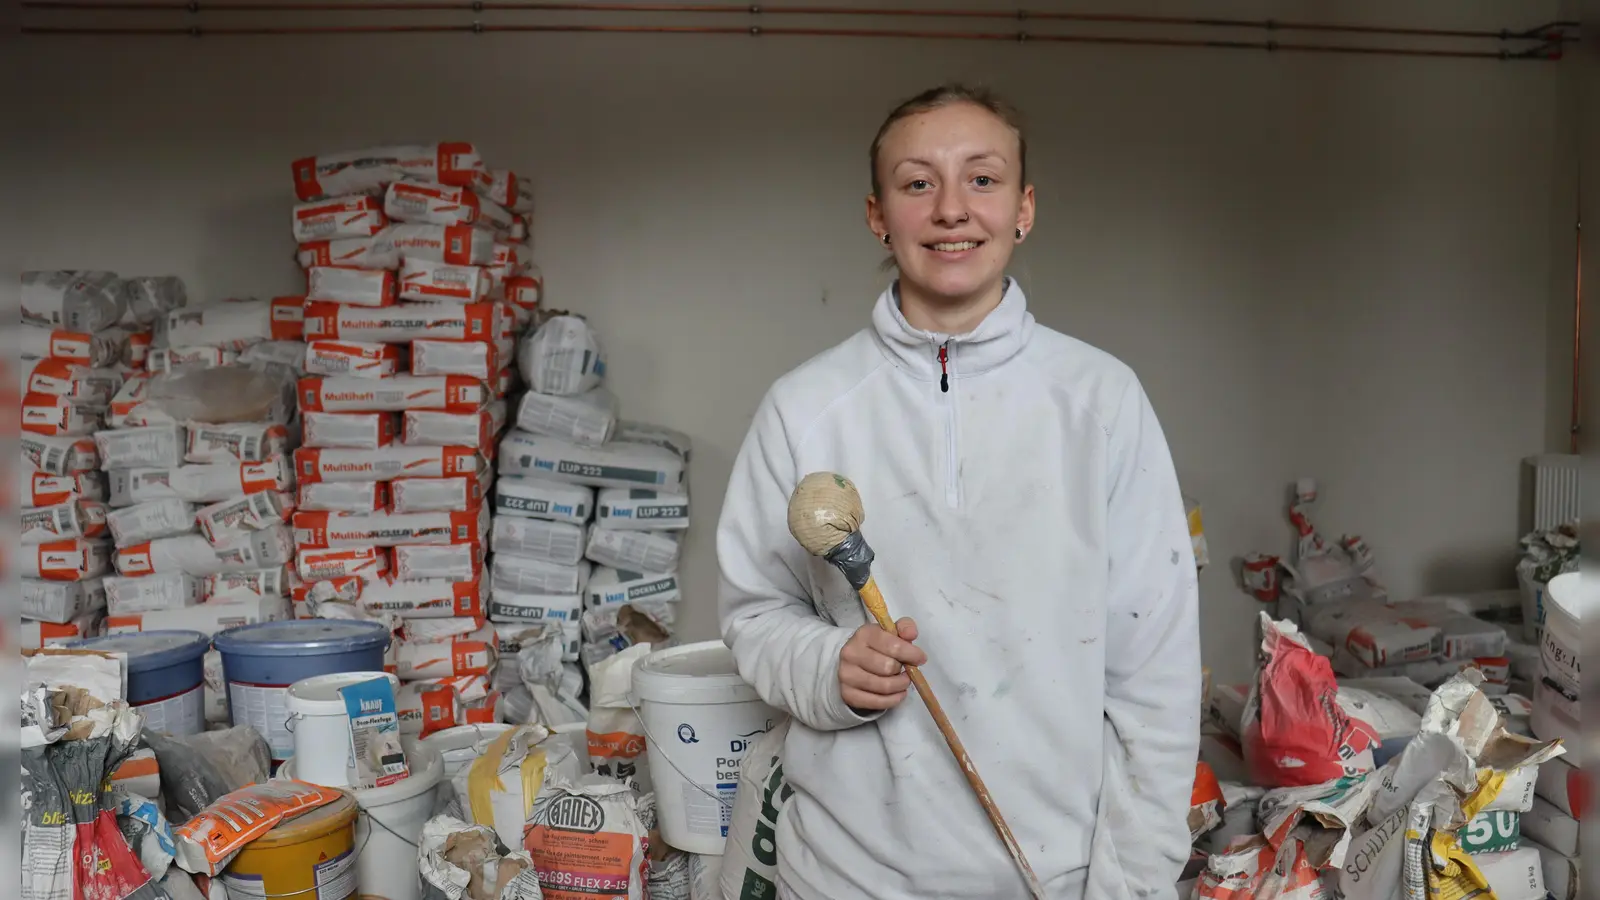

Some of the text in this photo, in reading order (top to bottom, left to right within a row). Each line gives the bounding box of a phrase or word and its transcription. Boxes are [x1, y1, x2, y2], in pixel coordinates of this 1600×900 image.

[325, 392, 374, 402] Multihaft
[323, 463, 372, 472] Multihaft
[560, 463, 581, 473] LUP
[582, 465, 602, 476] 222
[505, 498, 547, 512] LUP 222
[638, 507, 659, 517] LUP
[661, 507, 681, 517] 222
[500, 606, 542, 618] LUP 222
[360, 698, 383, 712] KNAUF
[550, 798, 599, 828] ARDEX
[1466, 811, 1516, 845] 50
[550, 871, 572, 885] G9S
[574, 877, 601, 889] FLEX
[603, 880, 628, 890] 2-15
[750, 879, 767, 898] kg
